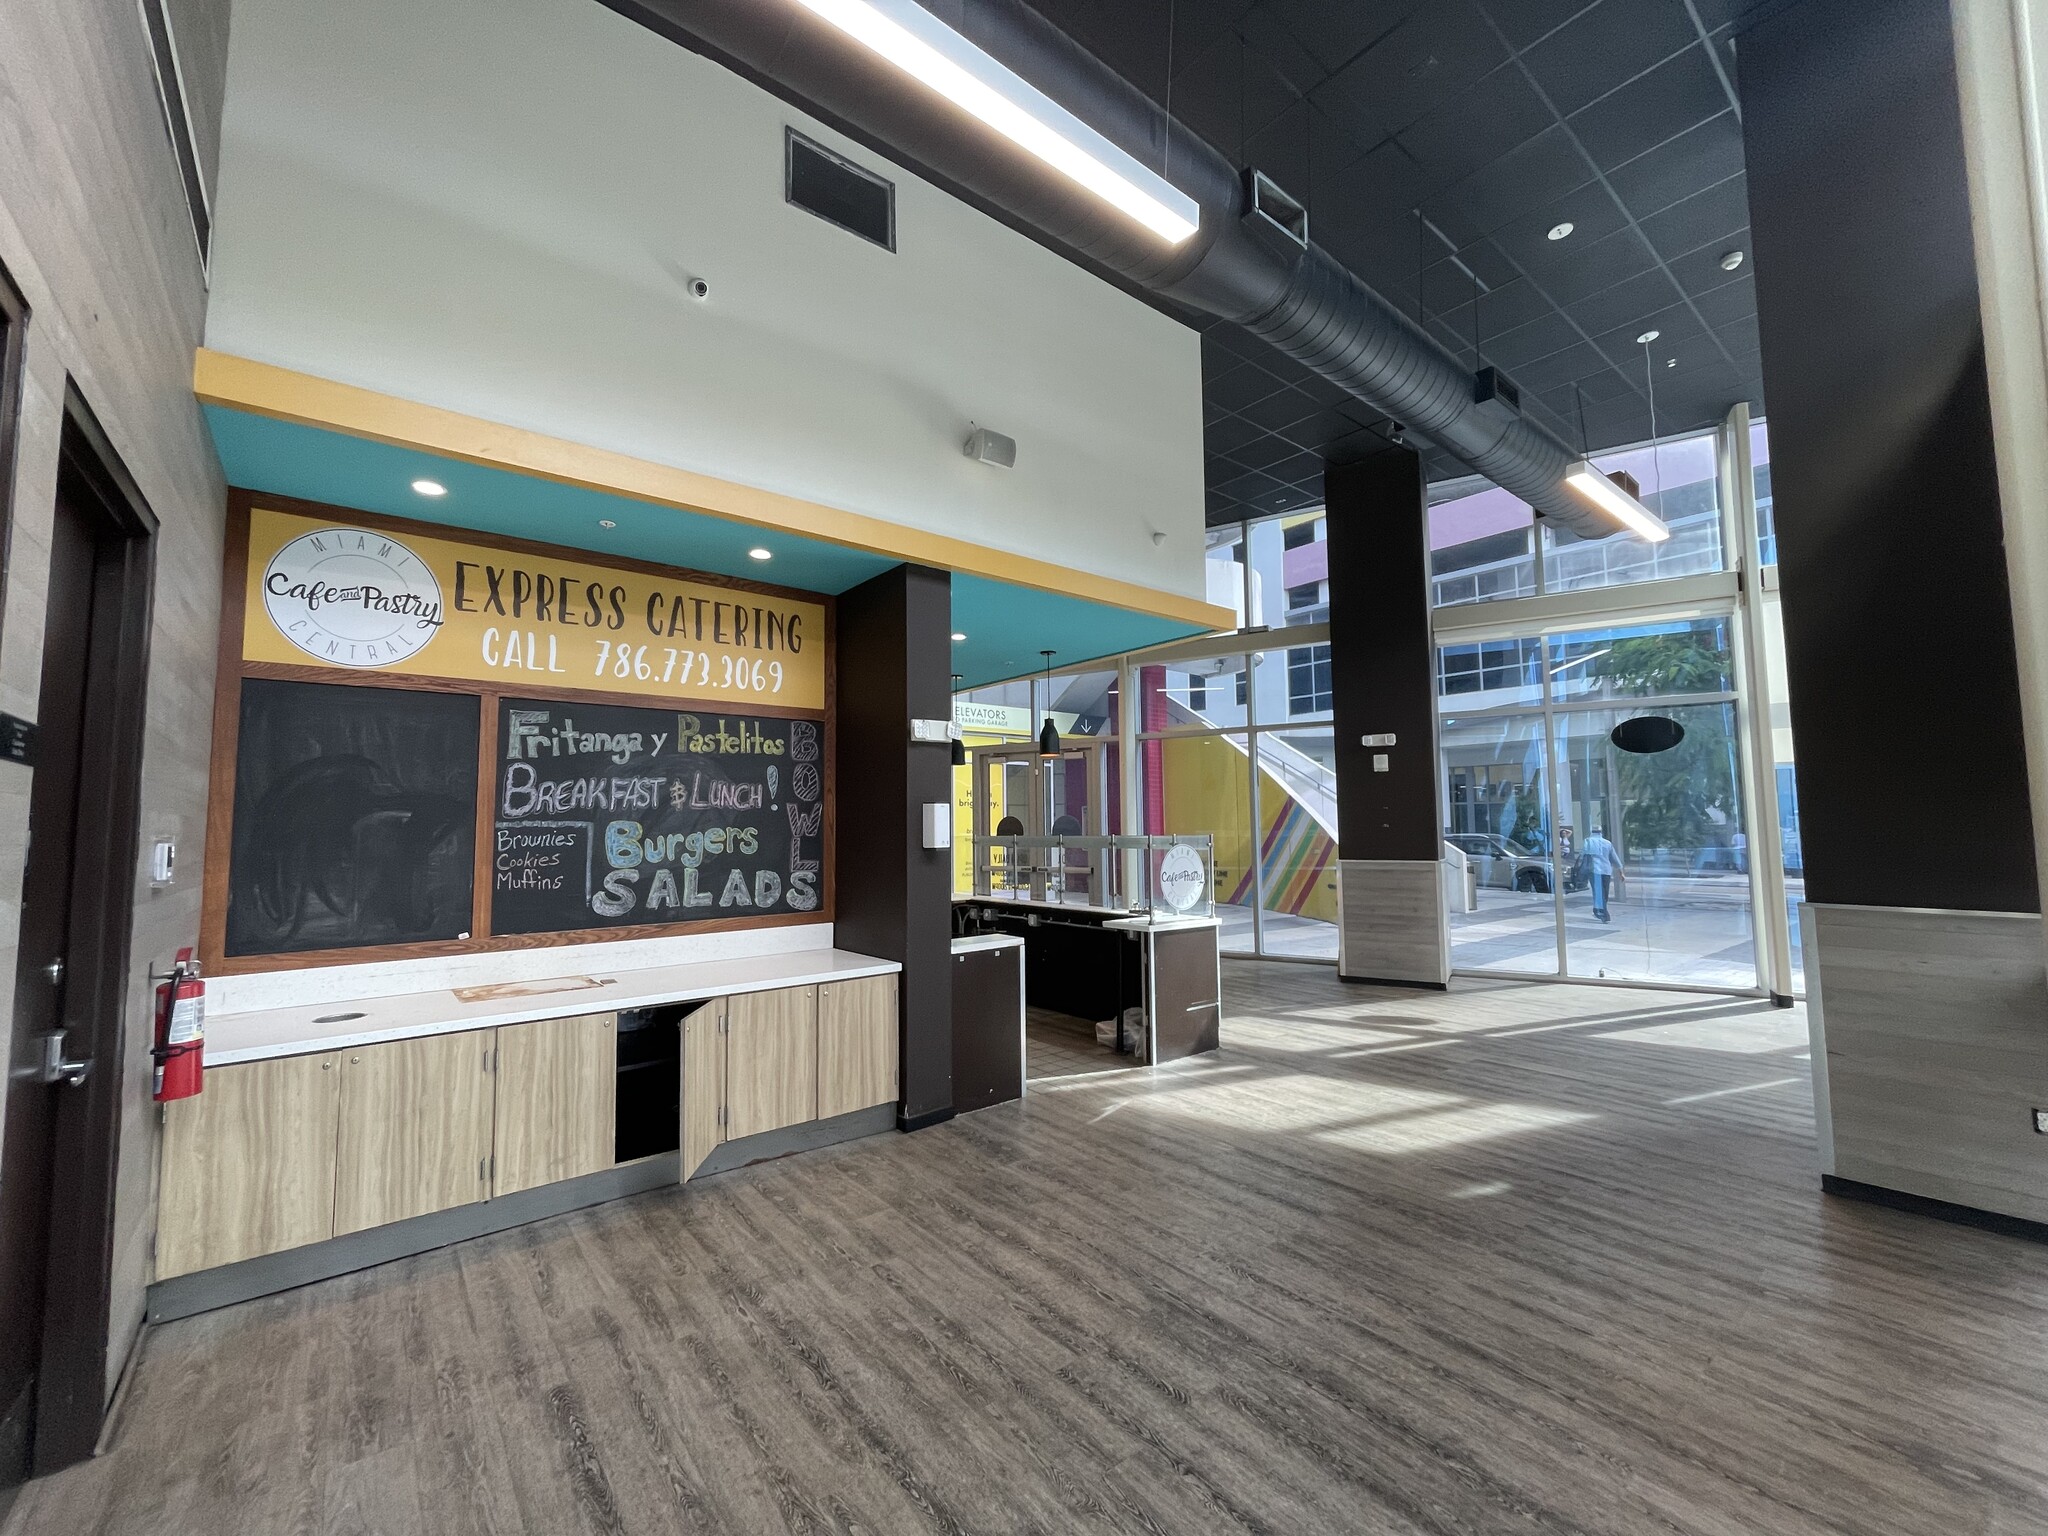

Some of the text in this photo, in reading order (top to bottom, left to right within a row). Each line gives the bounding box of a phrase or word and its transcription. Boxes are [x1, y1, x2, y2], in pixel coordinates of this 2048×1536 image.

[310, 534, 410, 567] MIAMI
[267, 572, 338, 611] Cafe
[360, 586, 444, 629] Pastry
[454, 561, 802, 654] EXPRESS CATERING
[289, 620, 413, 660] CENTRAL
[482, 627, 783, 693] CALL 786.773.3069
[507, 709, 785, 764] Fritanga y Pastelitos
[955, 706, 1006, 720] ELEVATORS
[501, 762, 667, 819] BREAKFAST
[496, 850, 561, 870] Cookies
[498, 829, 577, 850] Brownies
[605, 820, 759, 868] Burgers
[496, 868, 564, 890] Muffins
[592, 868, 817, 917] SALADS
